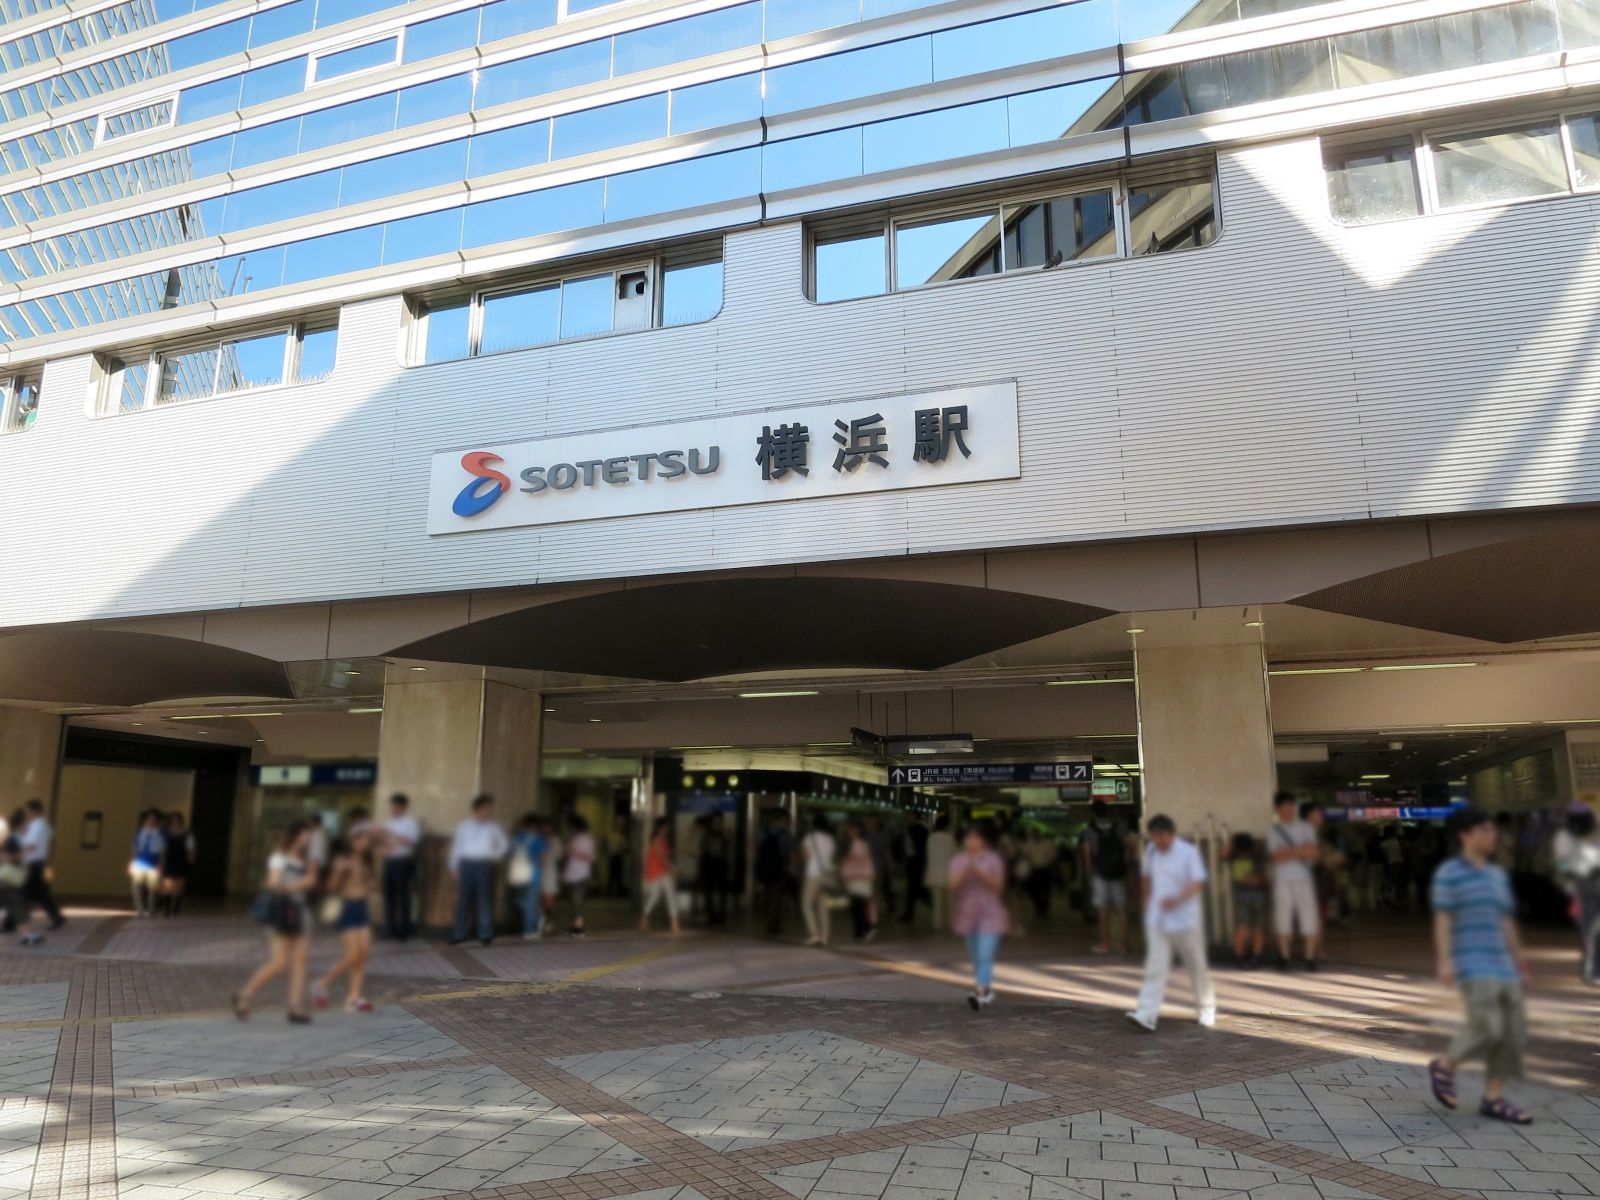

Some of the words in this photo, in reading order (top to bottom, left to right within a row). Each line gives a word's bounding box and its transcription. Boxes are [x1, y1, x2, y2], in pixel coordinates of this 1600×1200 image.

[520, 446, 720, 494] SOTETSU
[755, 405, 972, 480] 横浜駅
